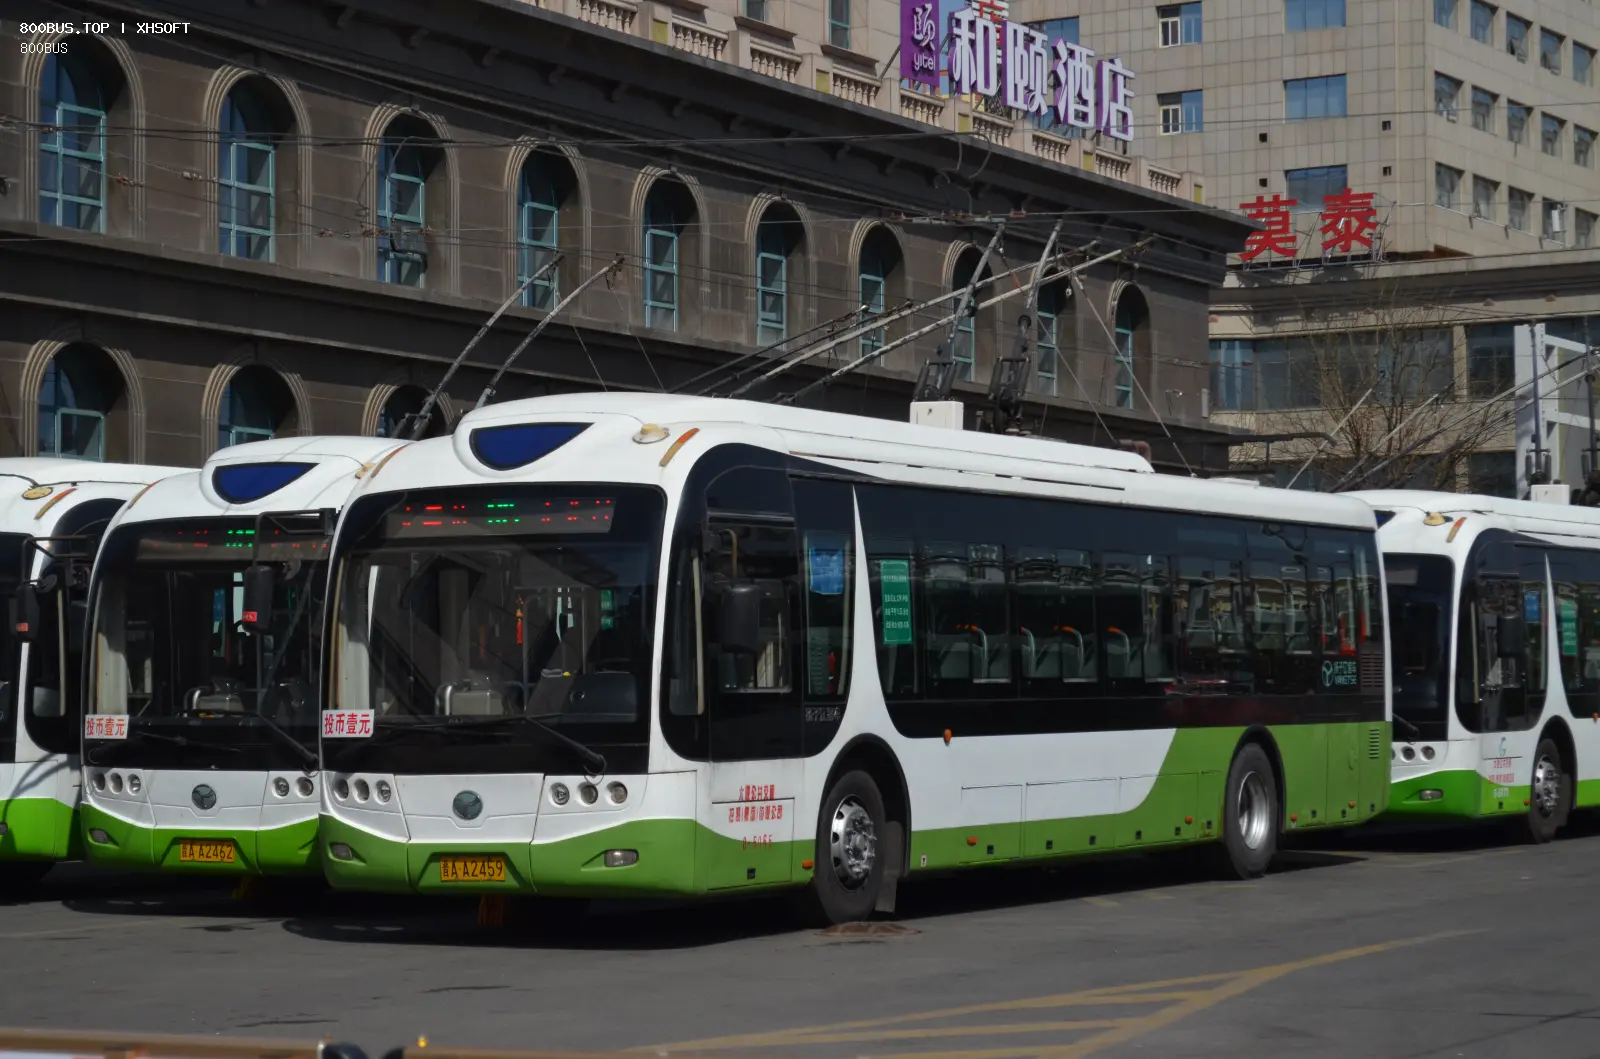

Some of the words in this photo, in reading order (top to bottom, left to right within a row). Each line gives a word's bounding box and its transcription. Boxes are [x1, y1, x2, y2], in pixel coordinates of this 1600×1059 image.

[913, 53, 936, 71] yitel
[950, 7, 1136, 142] 和颐酒店
[1238, 187, 1379, 262] 莫泰
[86, 716, 125, 736] 投币壹元
[324, 713, 371, 735] 投币壹元
